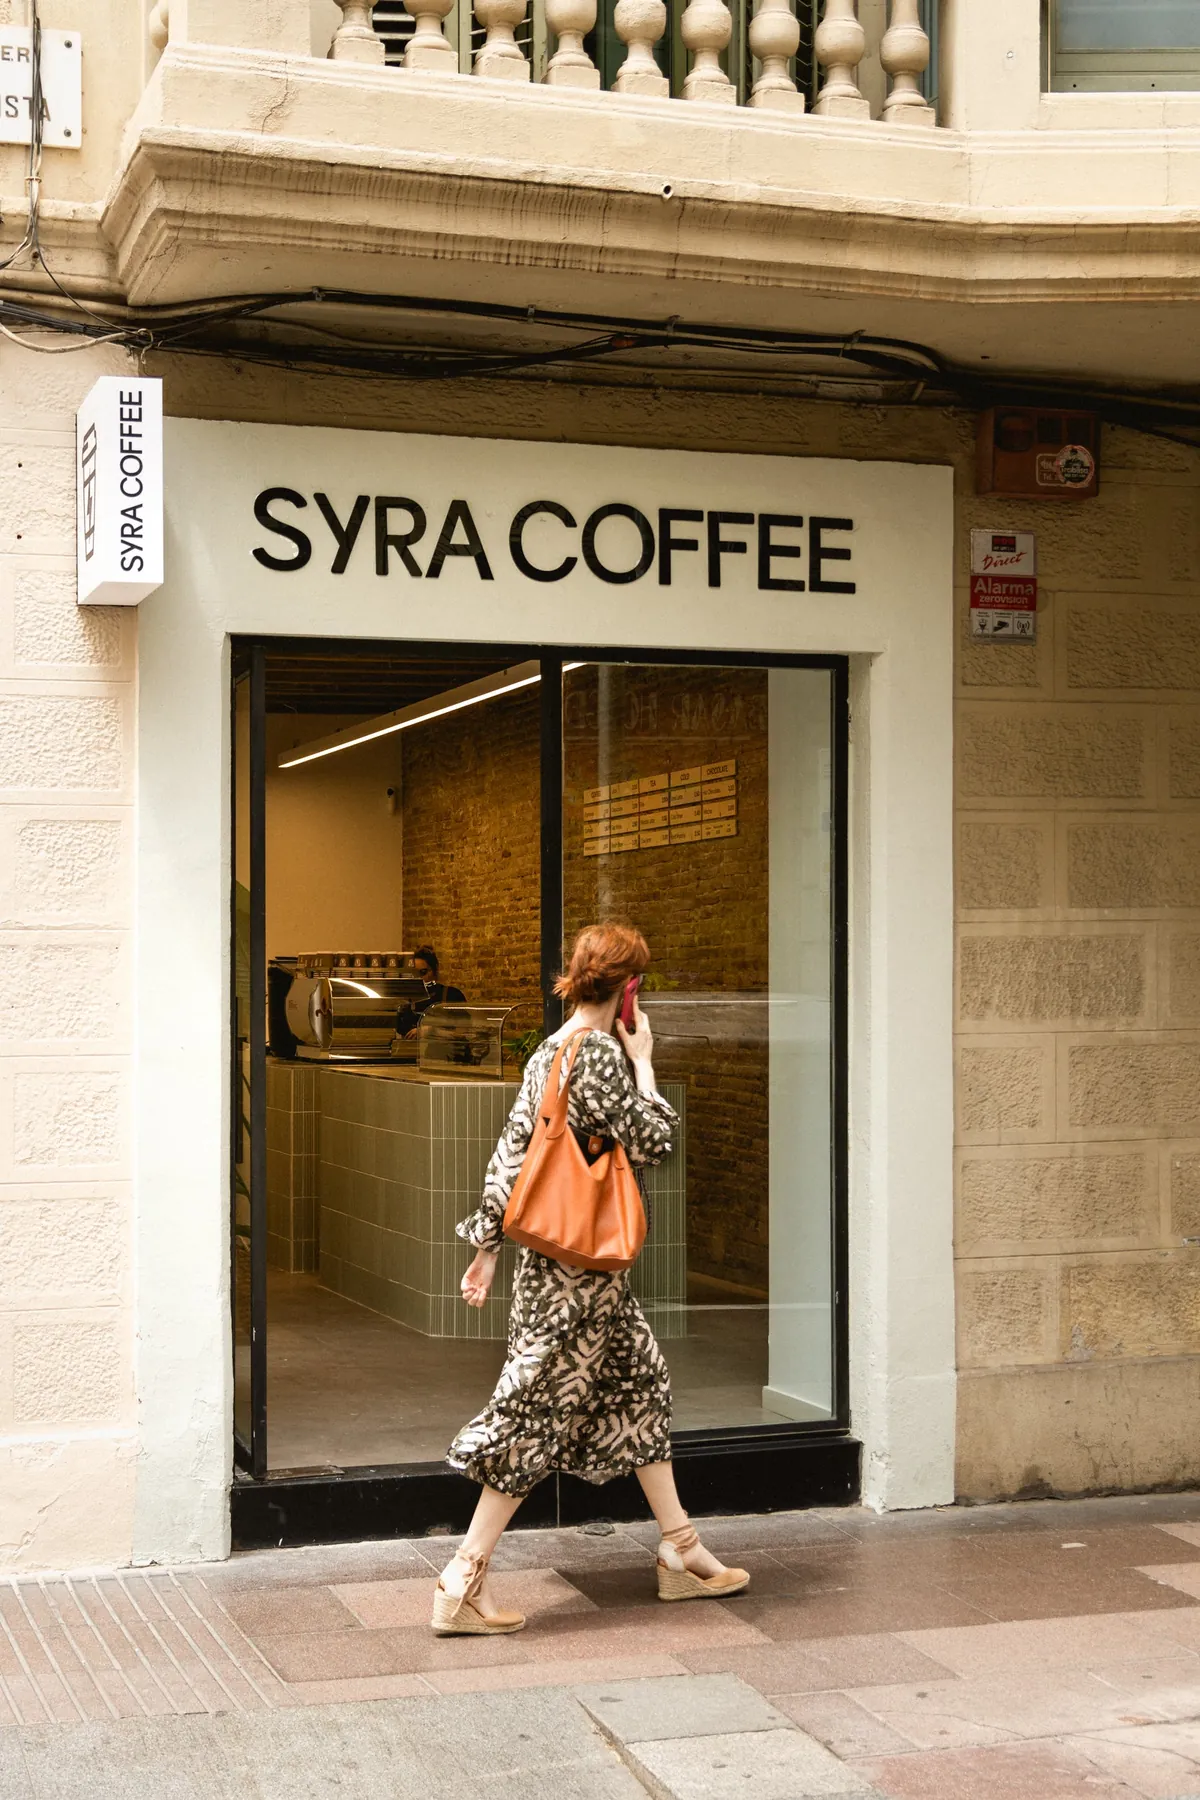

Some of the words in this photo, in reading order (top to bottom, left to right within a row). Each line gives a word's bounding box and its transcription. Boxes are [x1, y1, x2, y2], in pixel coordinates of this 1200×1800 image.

[120, 390, 143, 497] COFFEE
[120, 503, 144, 572] SYRA
[252, 486, 495, 581] SYRA
[508, 500, 857, 595] COFFEE
[981, 552, 1028, 570] Direct
[973, 578, 1034, 595] Alarma
[979, 595, 1029, 604] zerovision
[706, 765, 728, 775] CHOCOLATE
